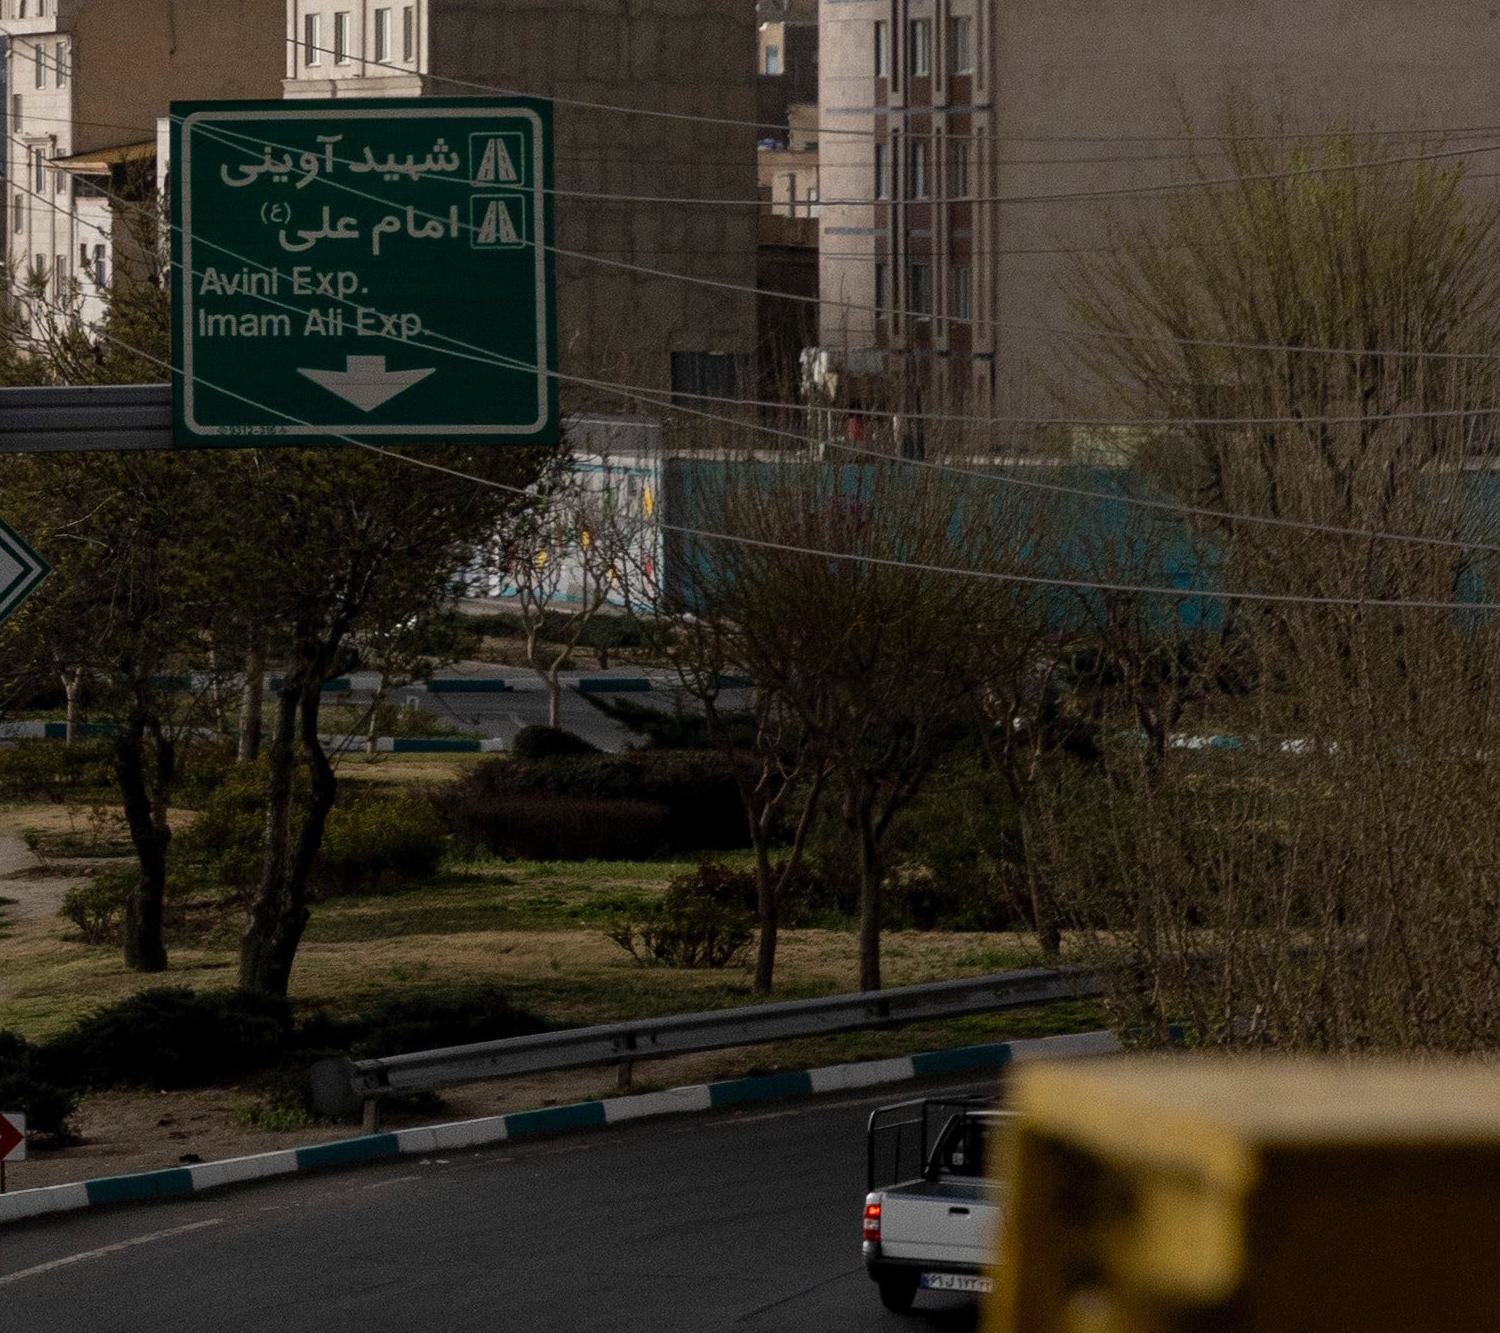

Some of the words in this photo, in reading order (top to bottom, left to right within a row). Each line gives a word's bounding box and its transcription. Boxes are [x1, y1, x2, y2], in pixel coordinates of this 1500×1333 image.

[221, 134, 343, 189] آوینی
[349, 137, 460, 182] شهید
[279, 206, 360, 252] علی
[372, 206, 458, 255] امام
[199, 267, 278, 296] Avini
[292, 267, 369, 300] Exp.
[199, 308, 290, 337] Imam
[304, 308, 343, 336] Ali
[356, 308, 432, 341] Exp.
